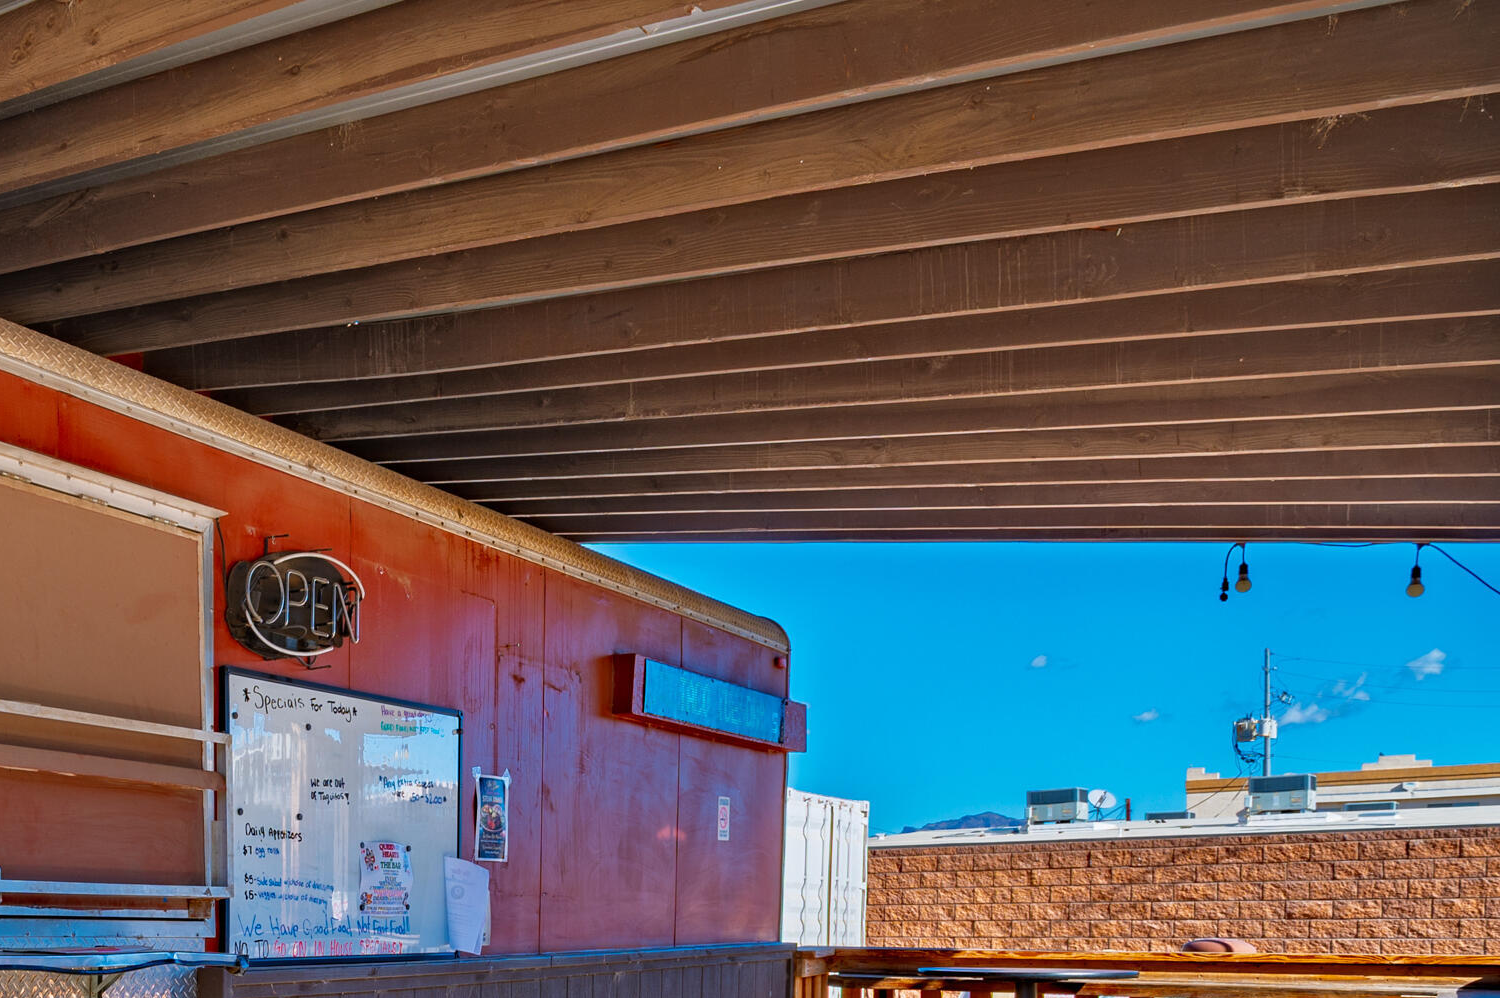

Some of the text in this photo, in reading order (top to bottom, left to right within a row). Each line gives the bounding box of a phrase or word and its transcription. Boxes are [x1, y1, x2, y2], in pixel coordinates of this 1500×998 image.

[246, 560, 360, 645] OPEN
[310, 698, 323, 712] For
[310, 777, 345, 789] We are out
[238, 913, 264, 937] We
[270, 914, 299, 938] Have
[302, 910, 329, 939] Good
[357, 914, 371, 936] Not
[254, 939, 269, 958] TO
[273, 938, 287, 958] GO
[314, 939, 326, 956] IN
[330, 938, 354, 957] HOUSE
